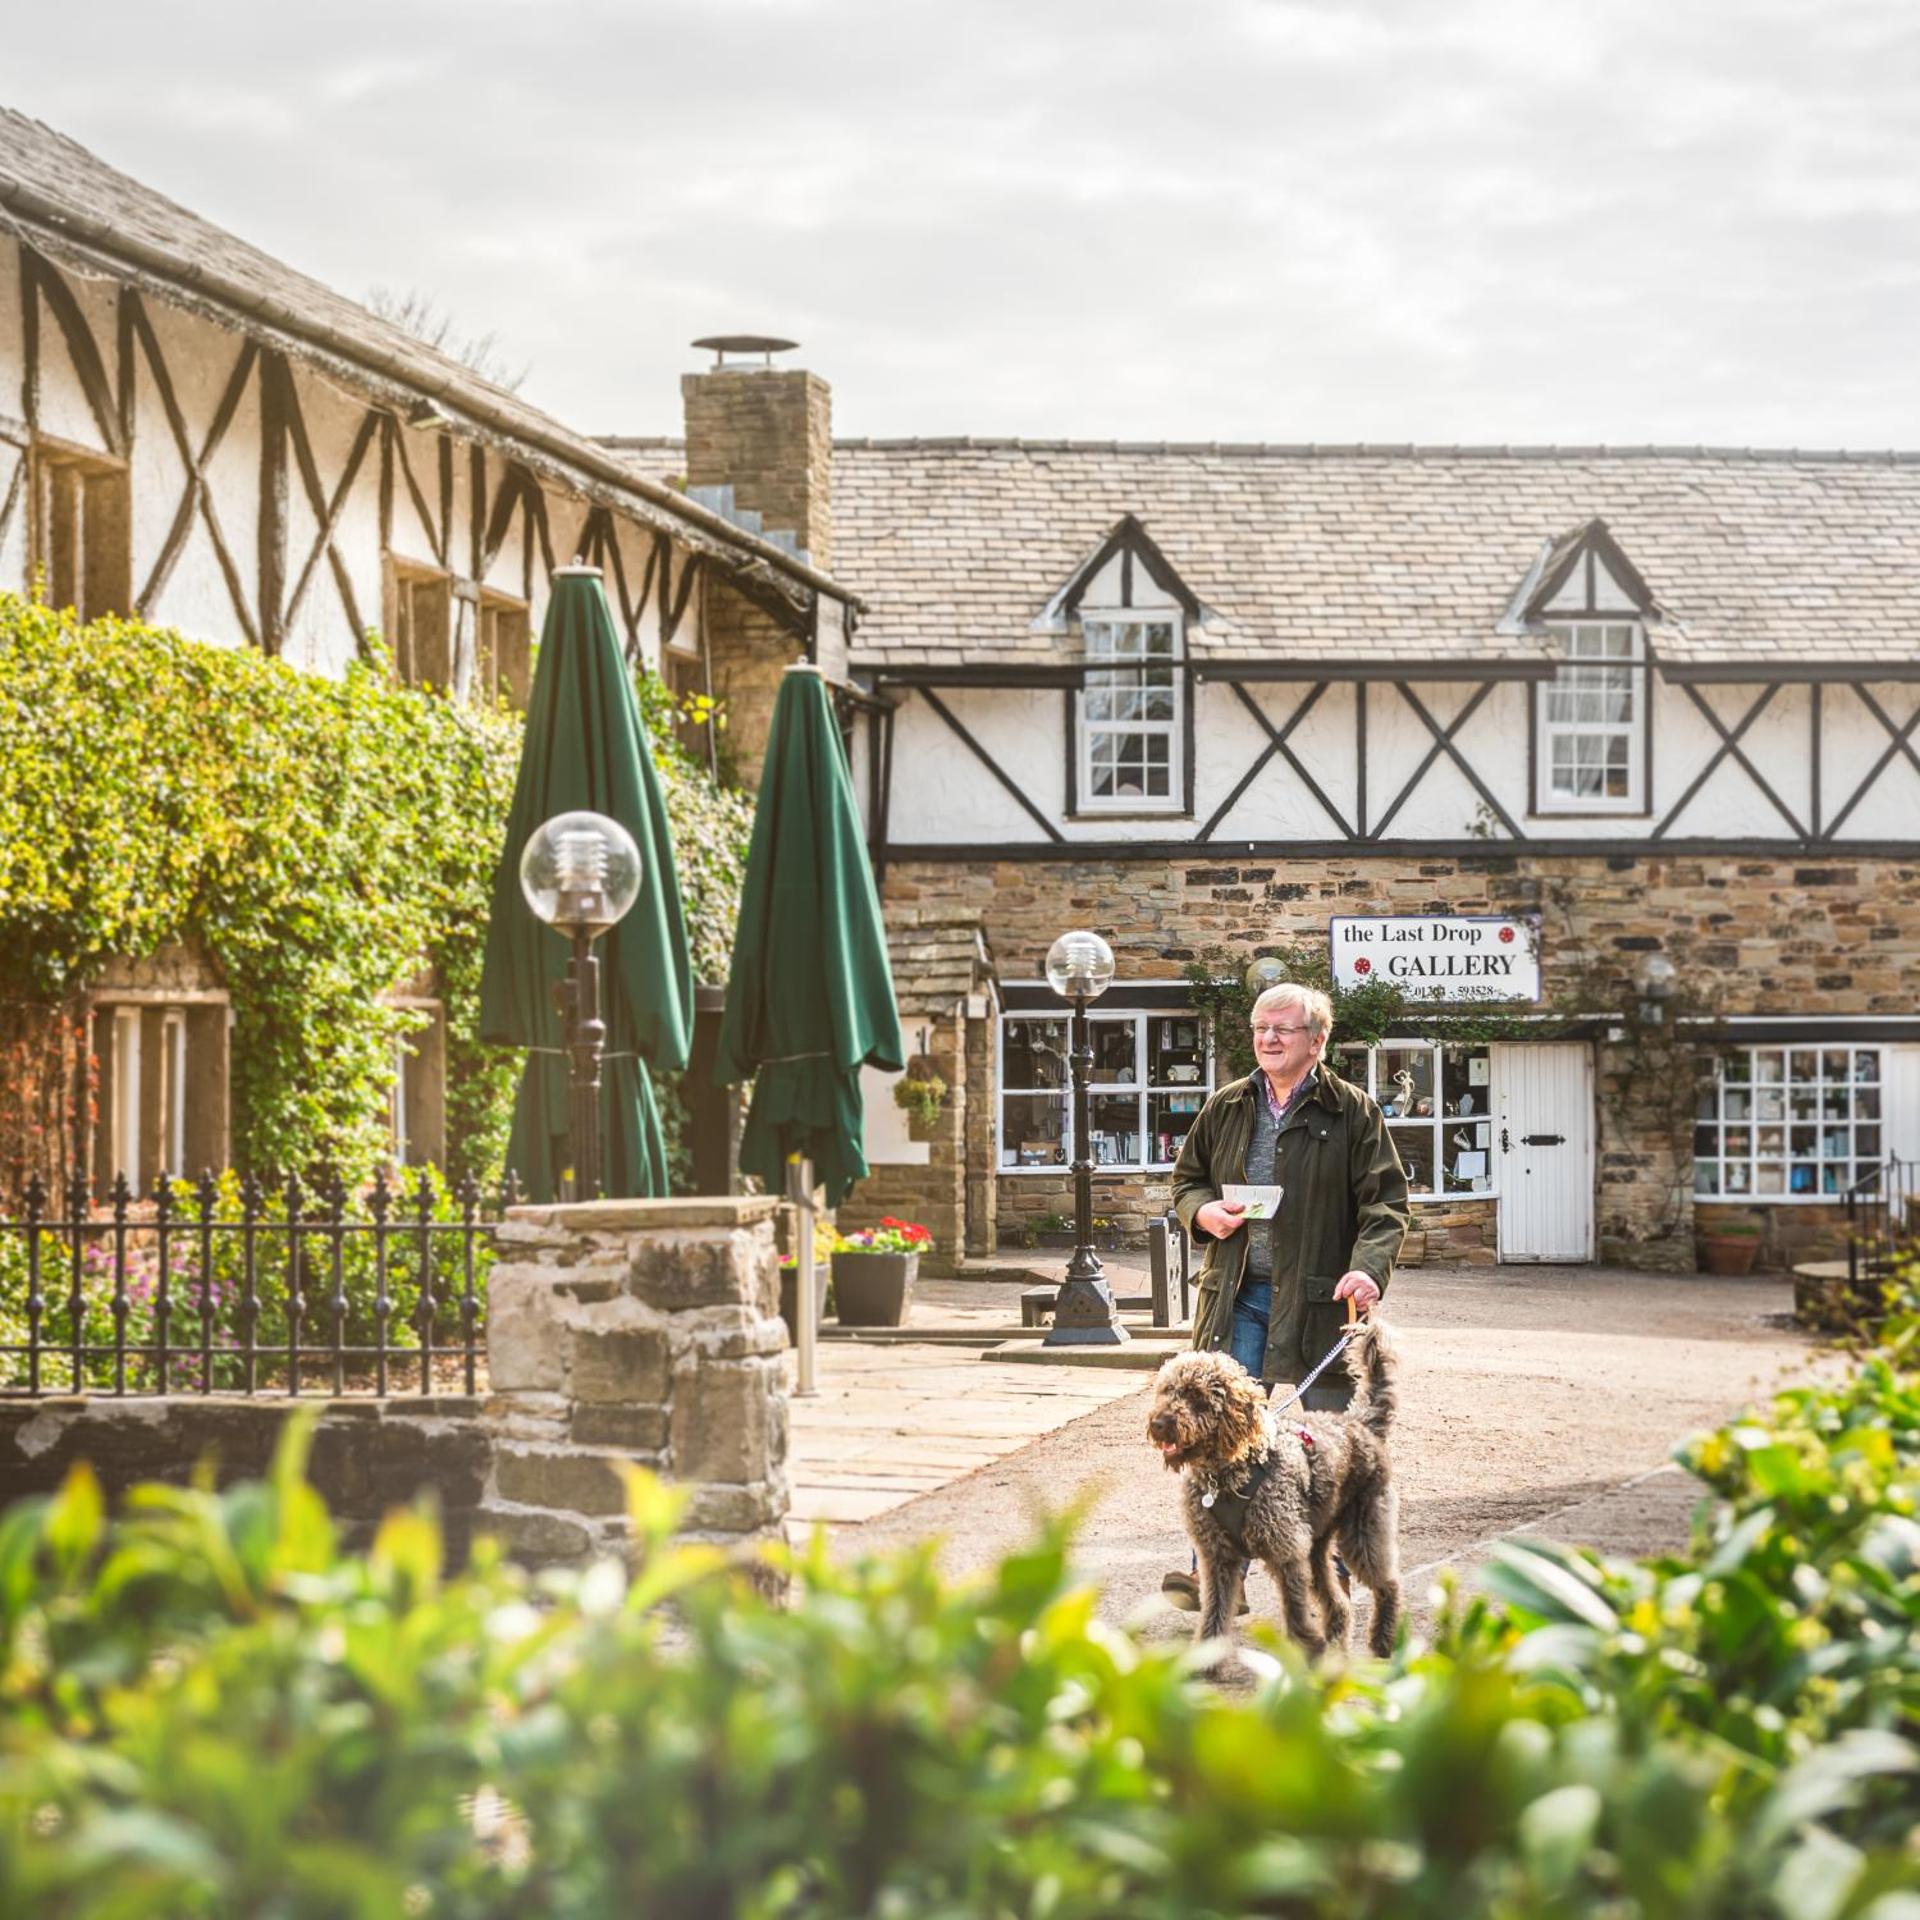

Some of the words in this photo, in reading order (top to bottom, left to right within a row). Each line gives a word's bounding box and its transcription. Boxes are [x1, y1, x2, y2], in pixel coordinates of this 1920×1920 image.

[1344, 925, 1373, 942] the
[1382, 924, 1423, 942] Last
[1432, 924, 1482, 945] Drop
[1388, 954, 1516, 976] GALLERY
